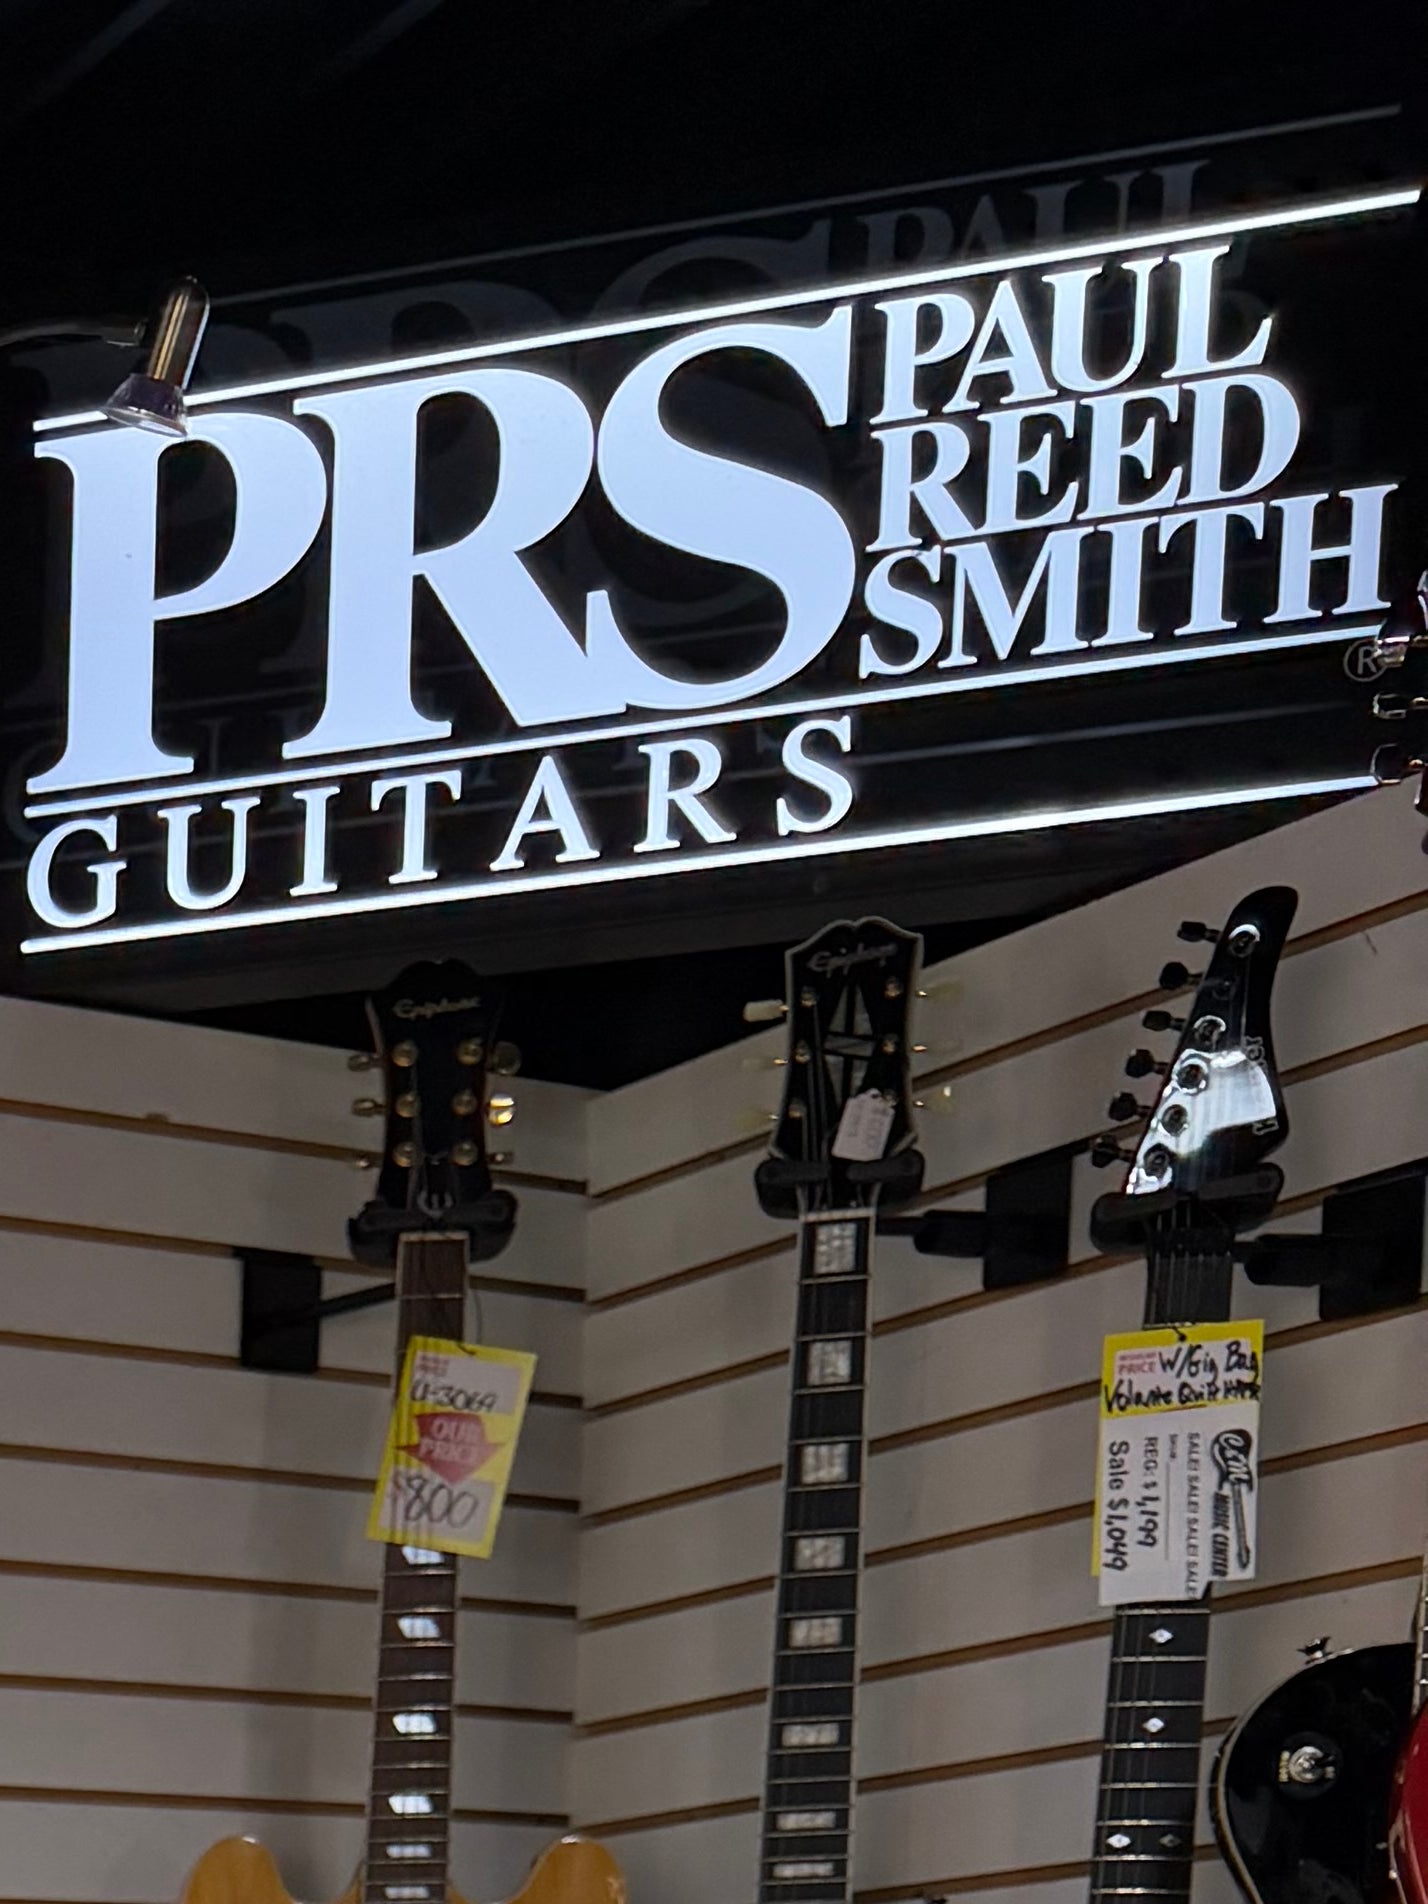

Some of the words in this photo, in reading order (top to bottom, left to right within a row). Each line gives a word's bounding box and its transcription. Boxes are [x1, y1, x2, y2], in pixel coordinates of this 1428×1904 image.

[874, 246, 1276, 426] PAUL
[30, 306, 855, 794] PRS
[867, 374, 1299, 553] REED
[857, 485, 1400, 682] SMITH
[25, 714, 855, 928] GUITARS
[1108, 1439, 1131, 1491] Sale
[1211, 1492, 1231, 1530] MUSIC
[1210, 1532, 1230, 1578] CENTER
